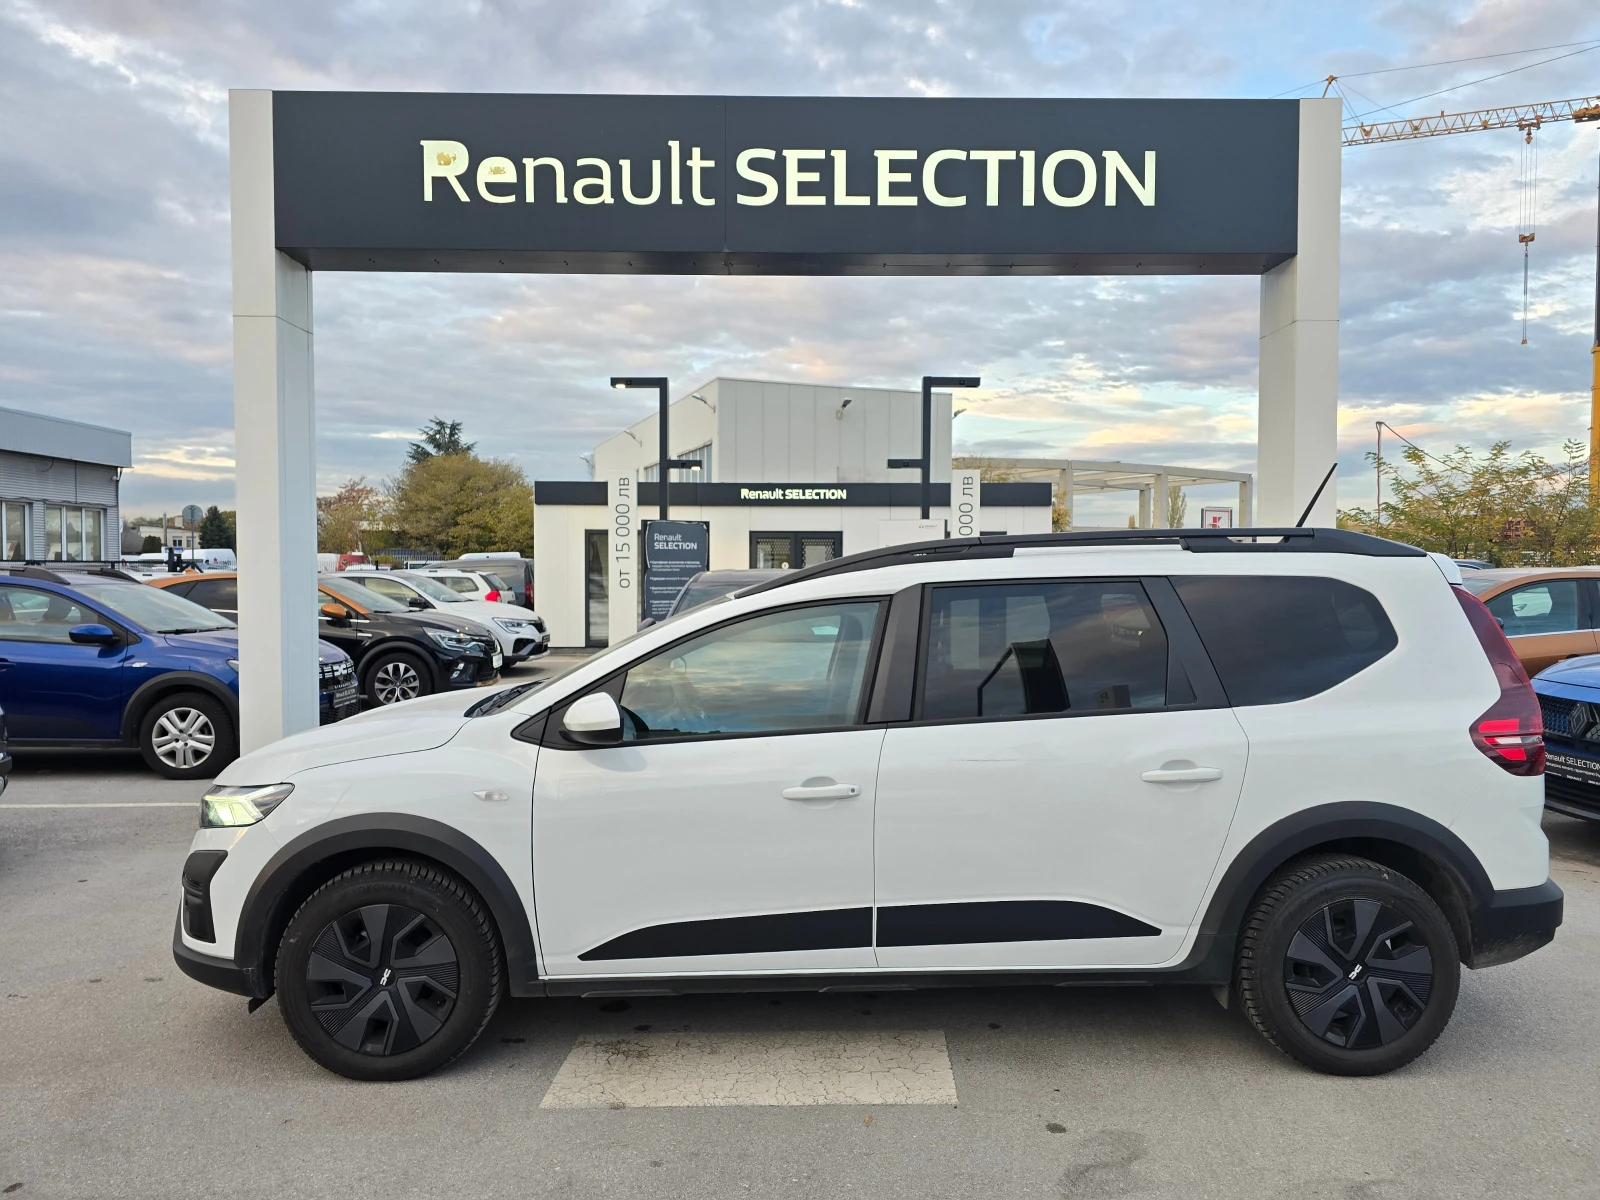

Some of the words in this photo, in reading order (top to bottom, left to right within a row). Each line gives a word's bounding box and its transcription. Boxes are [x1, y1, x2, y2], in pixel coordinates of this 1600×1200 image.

[420, 140, 715, 206] Renault
[736, 148, 1156, 207] SELECTION
[740, 488, 784, 499] Renault
[785, 489, 847, 499] SELECTION
[615, 503, 630, 537] 000
[958, 502, 973, 536] 000
[654, 533, 682, 541] Renault
[654, 541, 697, 550] SELECTION
[615, 543, 631, 563] 15
